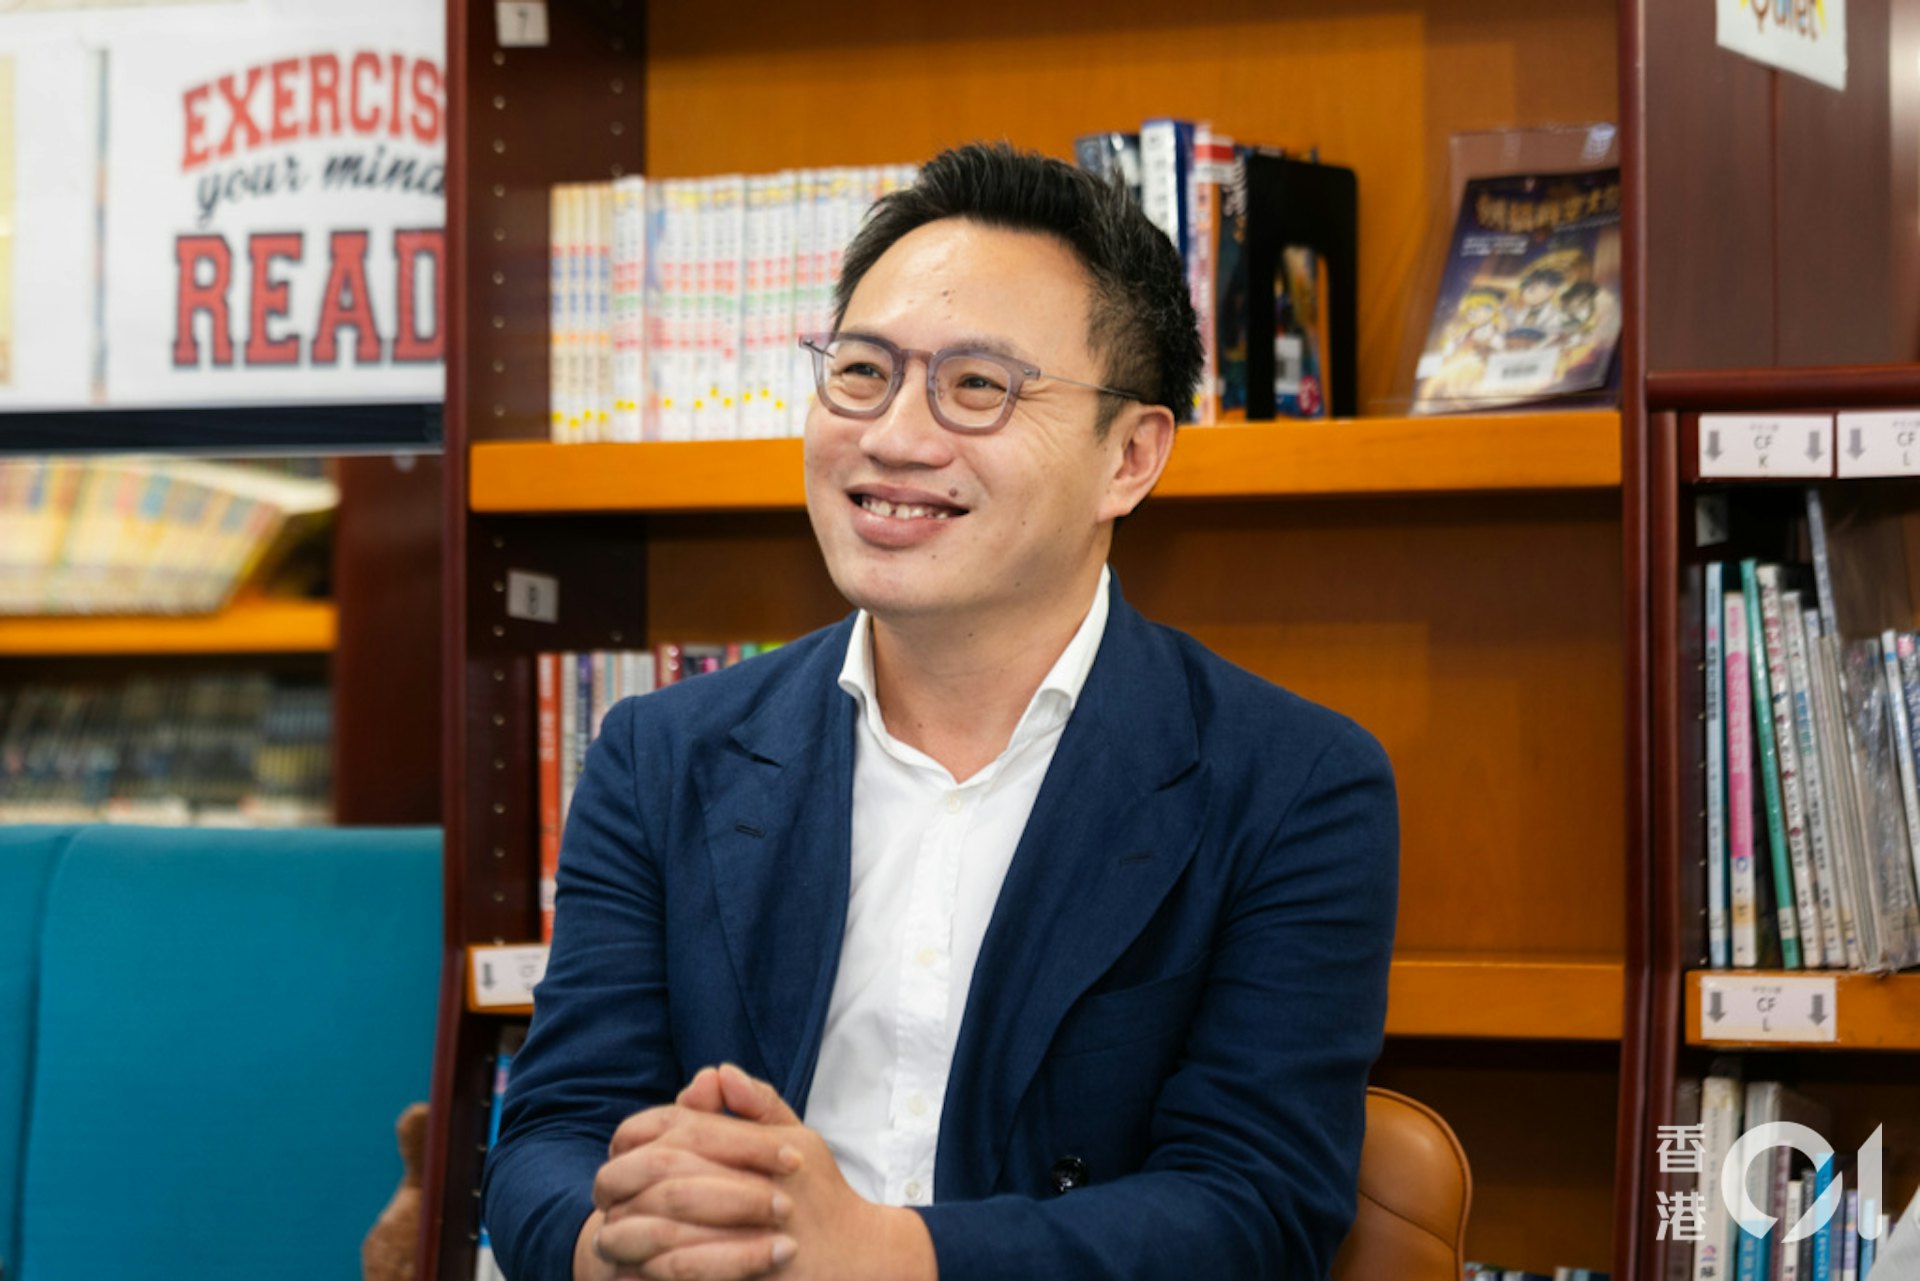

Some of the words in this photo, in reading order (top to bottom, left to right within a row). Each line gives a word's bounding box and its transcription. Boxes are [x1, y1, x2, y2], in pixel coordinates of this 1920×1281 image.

[181, 49, 445, 172] EXERCIS
[197, 154, 308, 230] your
[172, 227, 445, 368] READ
[1753, 435, 1774, 450] CF
[1896, 432, 1916, 447] CF
[1756, 996, 1776, 1012] CF
[1762, 1018, 1771, 1032] L
